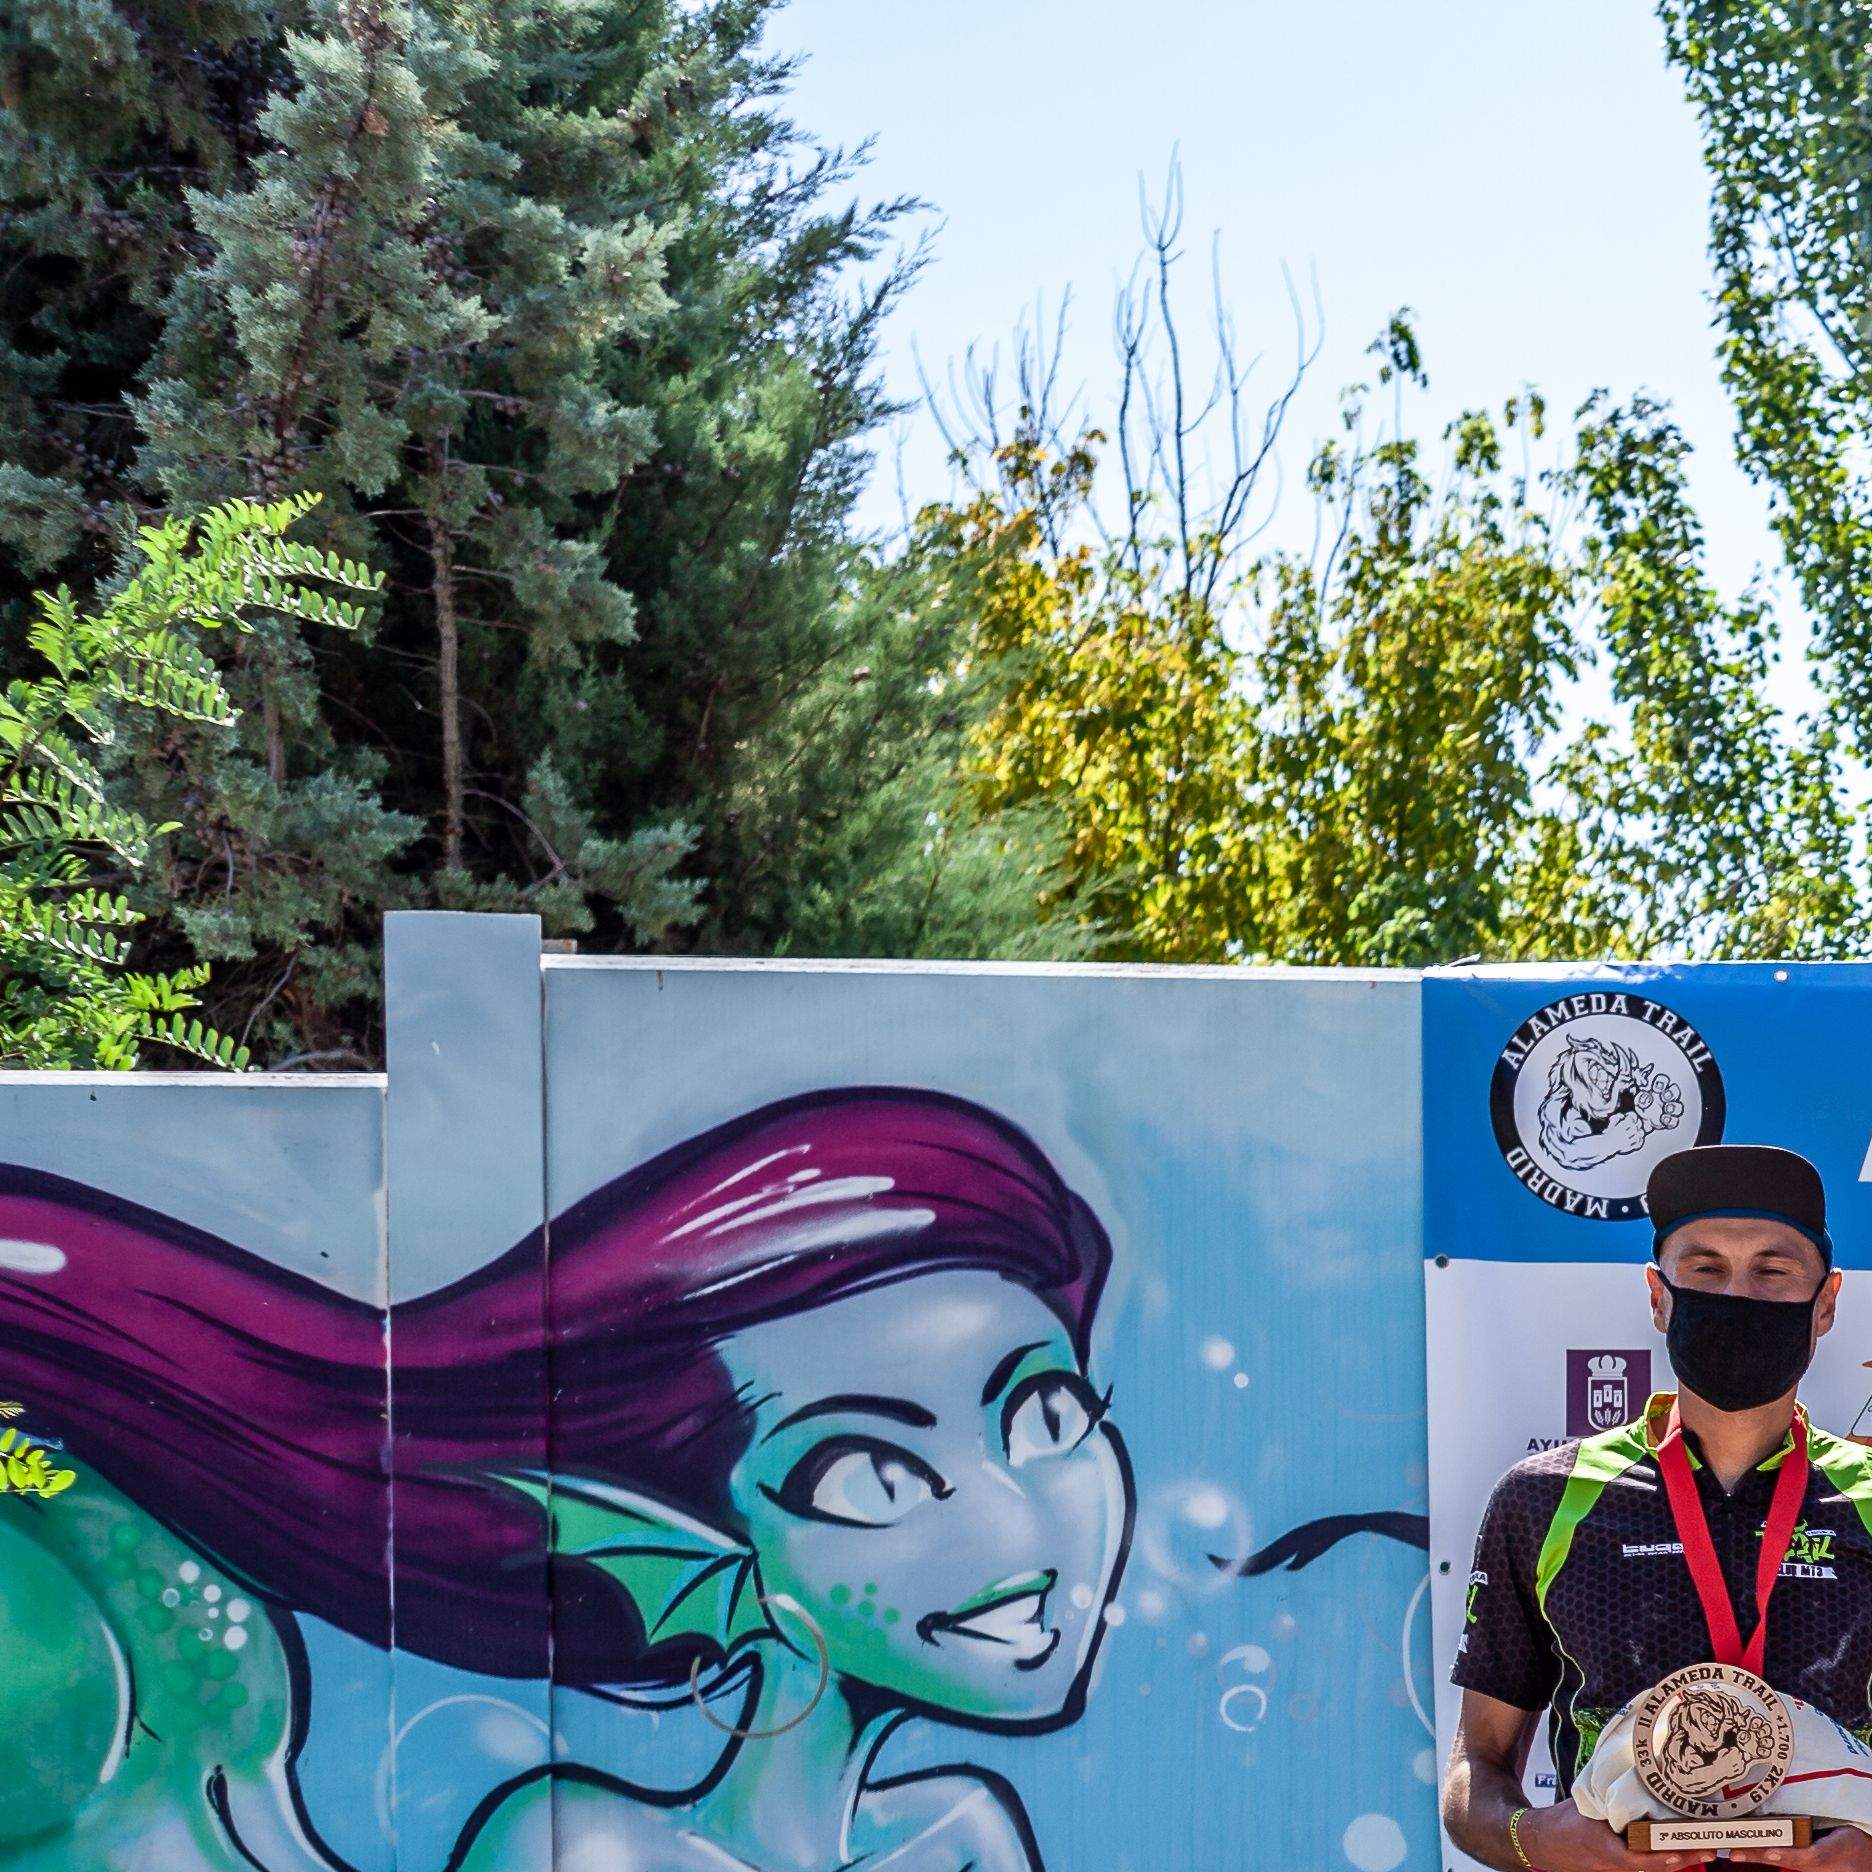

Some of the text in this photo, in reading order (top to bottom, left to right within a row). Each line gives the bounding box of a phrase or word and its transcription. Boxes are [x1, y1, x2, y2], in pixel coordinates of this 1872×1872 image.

[1501, 993, 1713, 1073] ALAMEDA TRAIL
[1507, 1146, 1610, 1219] MADRID
[1646, 1667, 1724, 1711] ALAMEDA
[1732, 1670, 1779, 1712] TRAIL
[1646, 1771, 1719, 1817] MADRID
[1670, 1831, 1723, 1840] ABSOLUTO
[1725, 1828, 1784, 1840] MASCULINO
